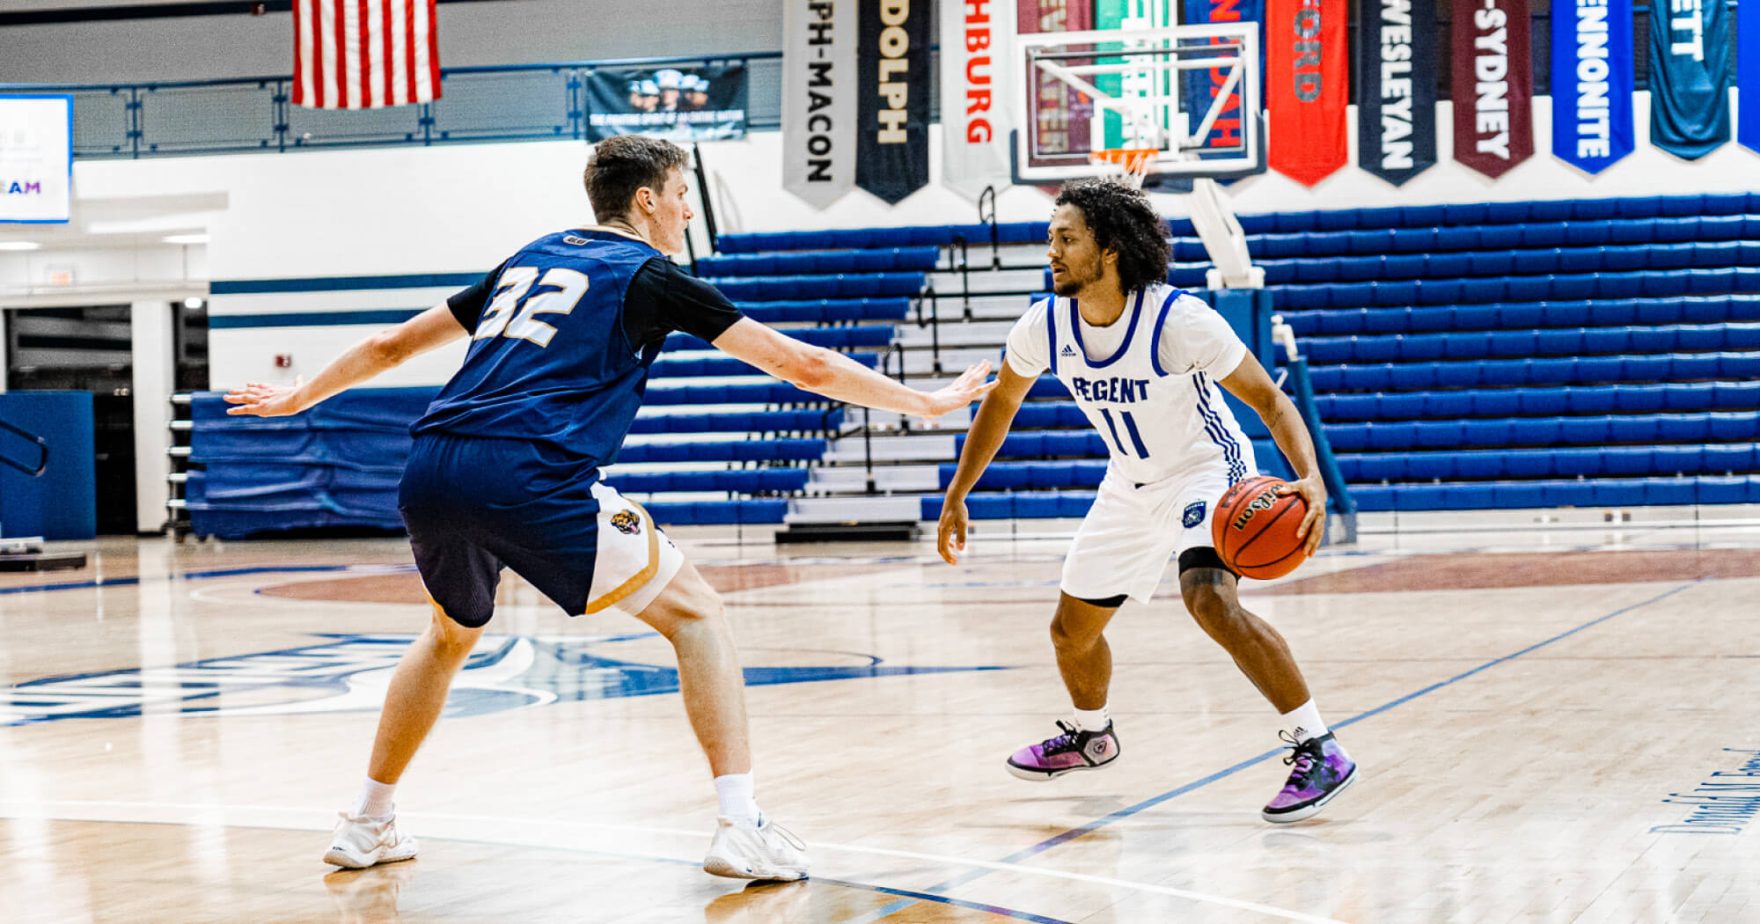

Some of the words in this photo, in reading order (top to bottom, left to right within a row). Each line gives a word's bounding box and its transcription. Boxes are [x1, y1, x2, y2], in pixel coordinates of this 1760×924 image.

[808, 0, 834, 182] PH-MACON
[877, 0, 909, 143] DOLPH
[965, 0, 992, 144] HBURG
[1381, 0, 1413, 169] WESLEYAN
[1474, 0, 1510, 160] -SYDNEY
[473, 266, 590, 348] 32
[1072, 377, 1150, 403] REGENT
[1097, 408, 1150, 460] 11
